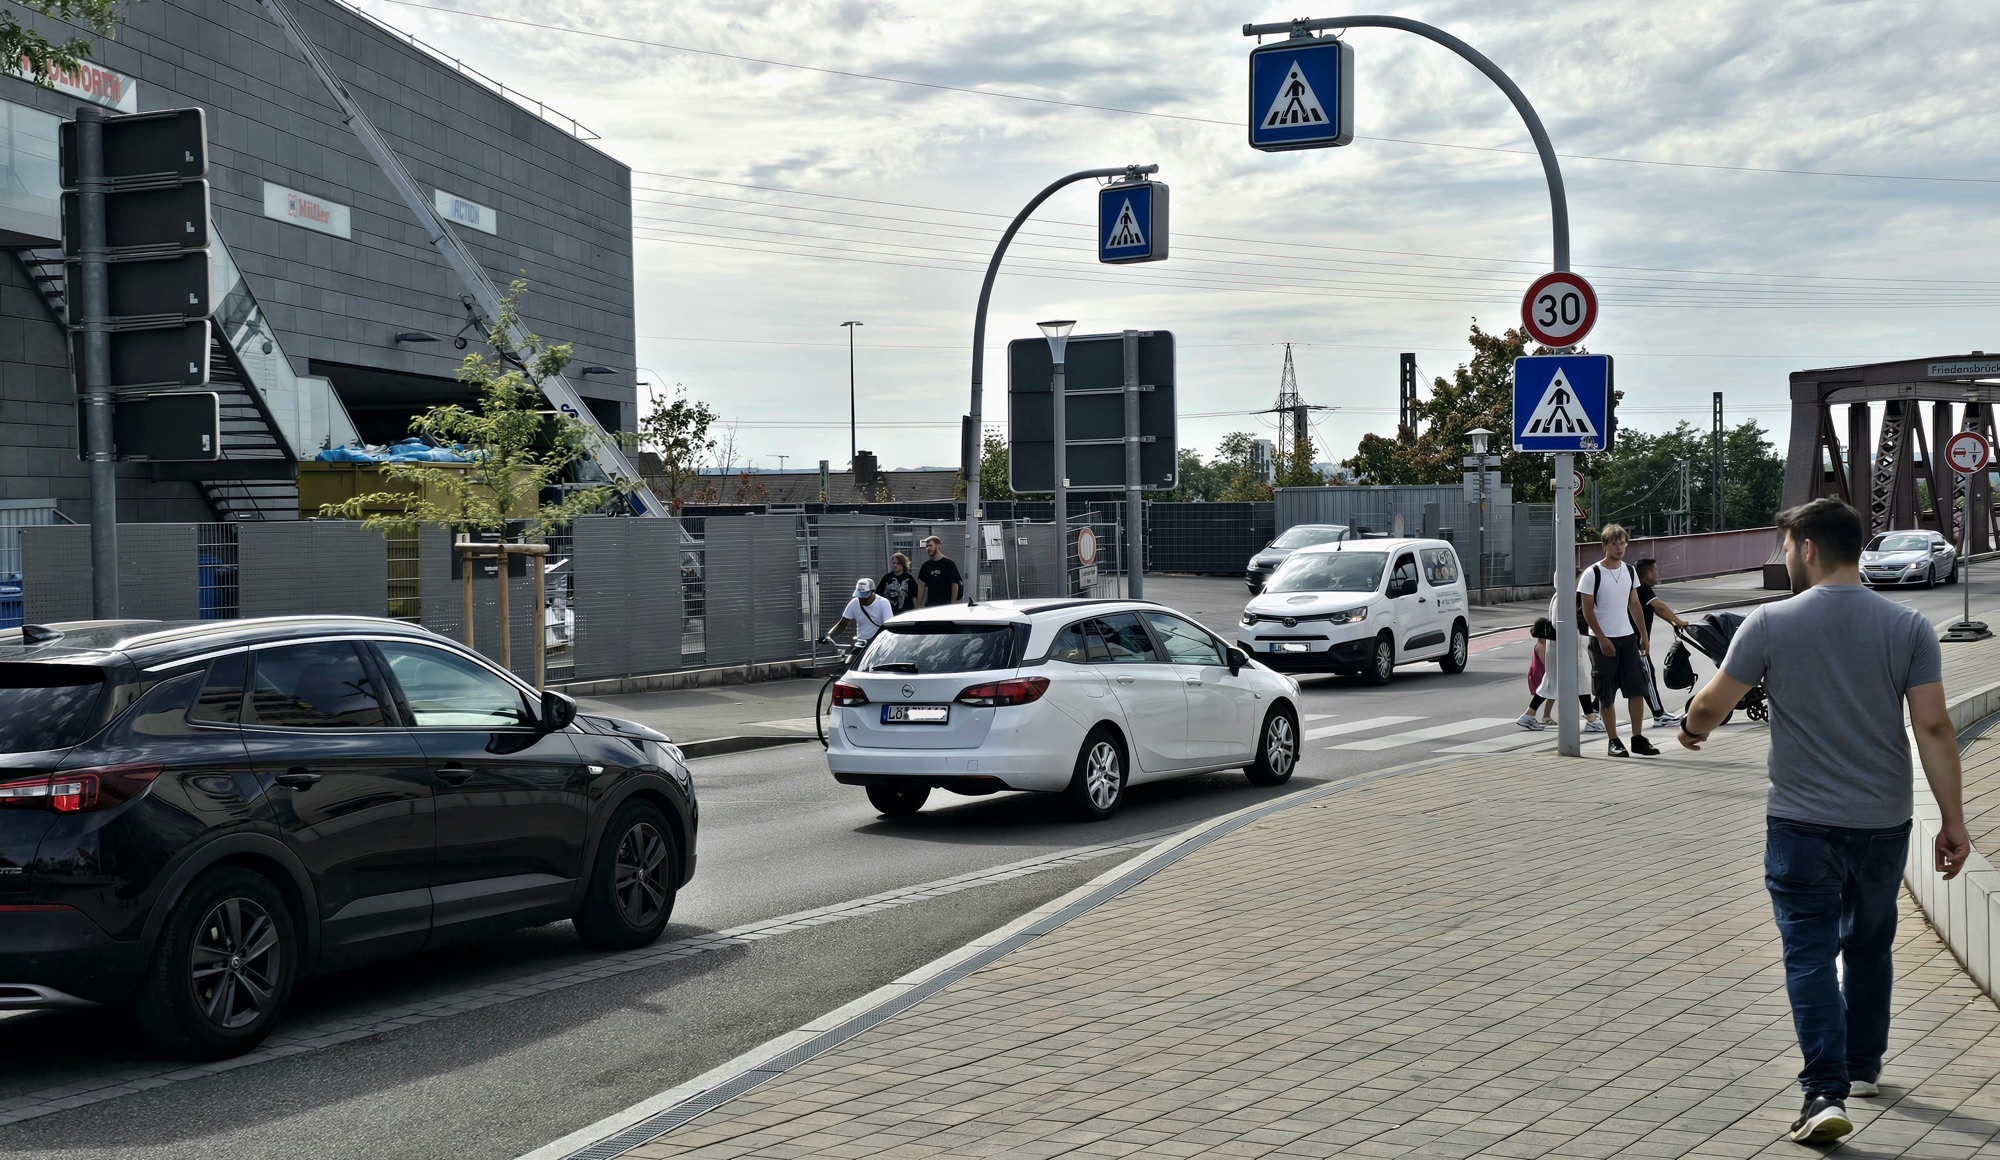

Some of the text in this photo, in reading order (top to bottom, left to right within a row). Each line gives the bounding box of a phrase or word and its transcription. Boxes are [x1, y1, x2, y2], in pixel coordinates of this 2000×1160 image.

[453, 200, 480, 225] ACTION
[1538, 292, 1581, 327] 30
[888, 706, 904, 720] LÖ
